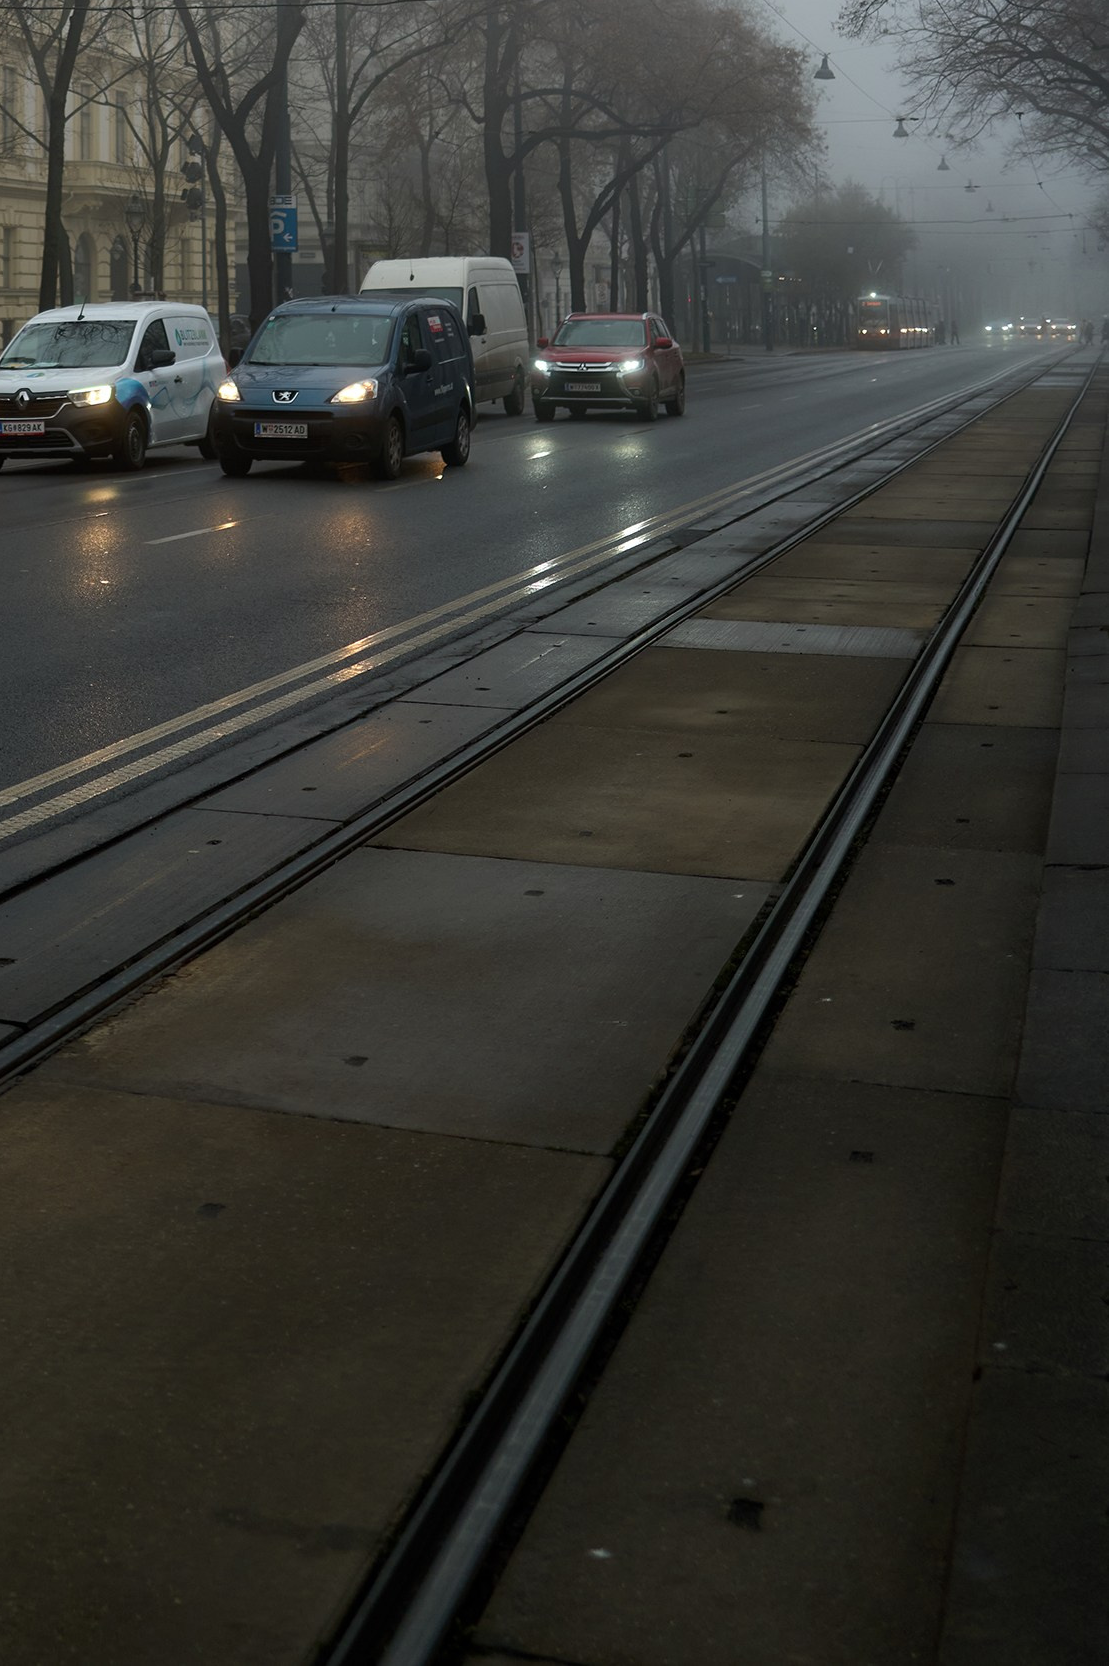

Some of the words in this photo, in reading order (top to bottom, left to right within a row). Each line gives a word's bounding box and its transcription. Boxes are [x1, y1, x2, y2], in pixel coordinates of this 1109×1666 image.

[3, 424, 13, 432] KG
[17, 424, 31, 432] 829
[32, 424, 42, 432] AK
[274, 425, 293, 434] 2512
[294, 425, 305, 434] AD
